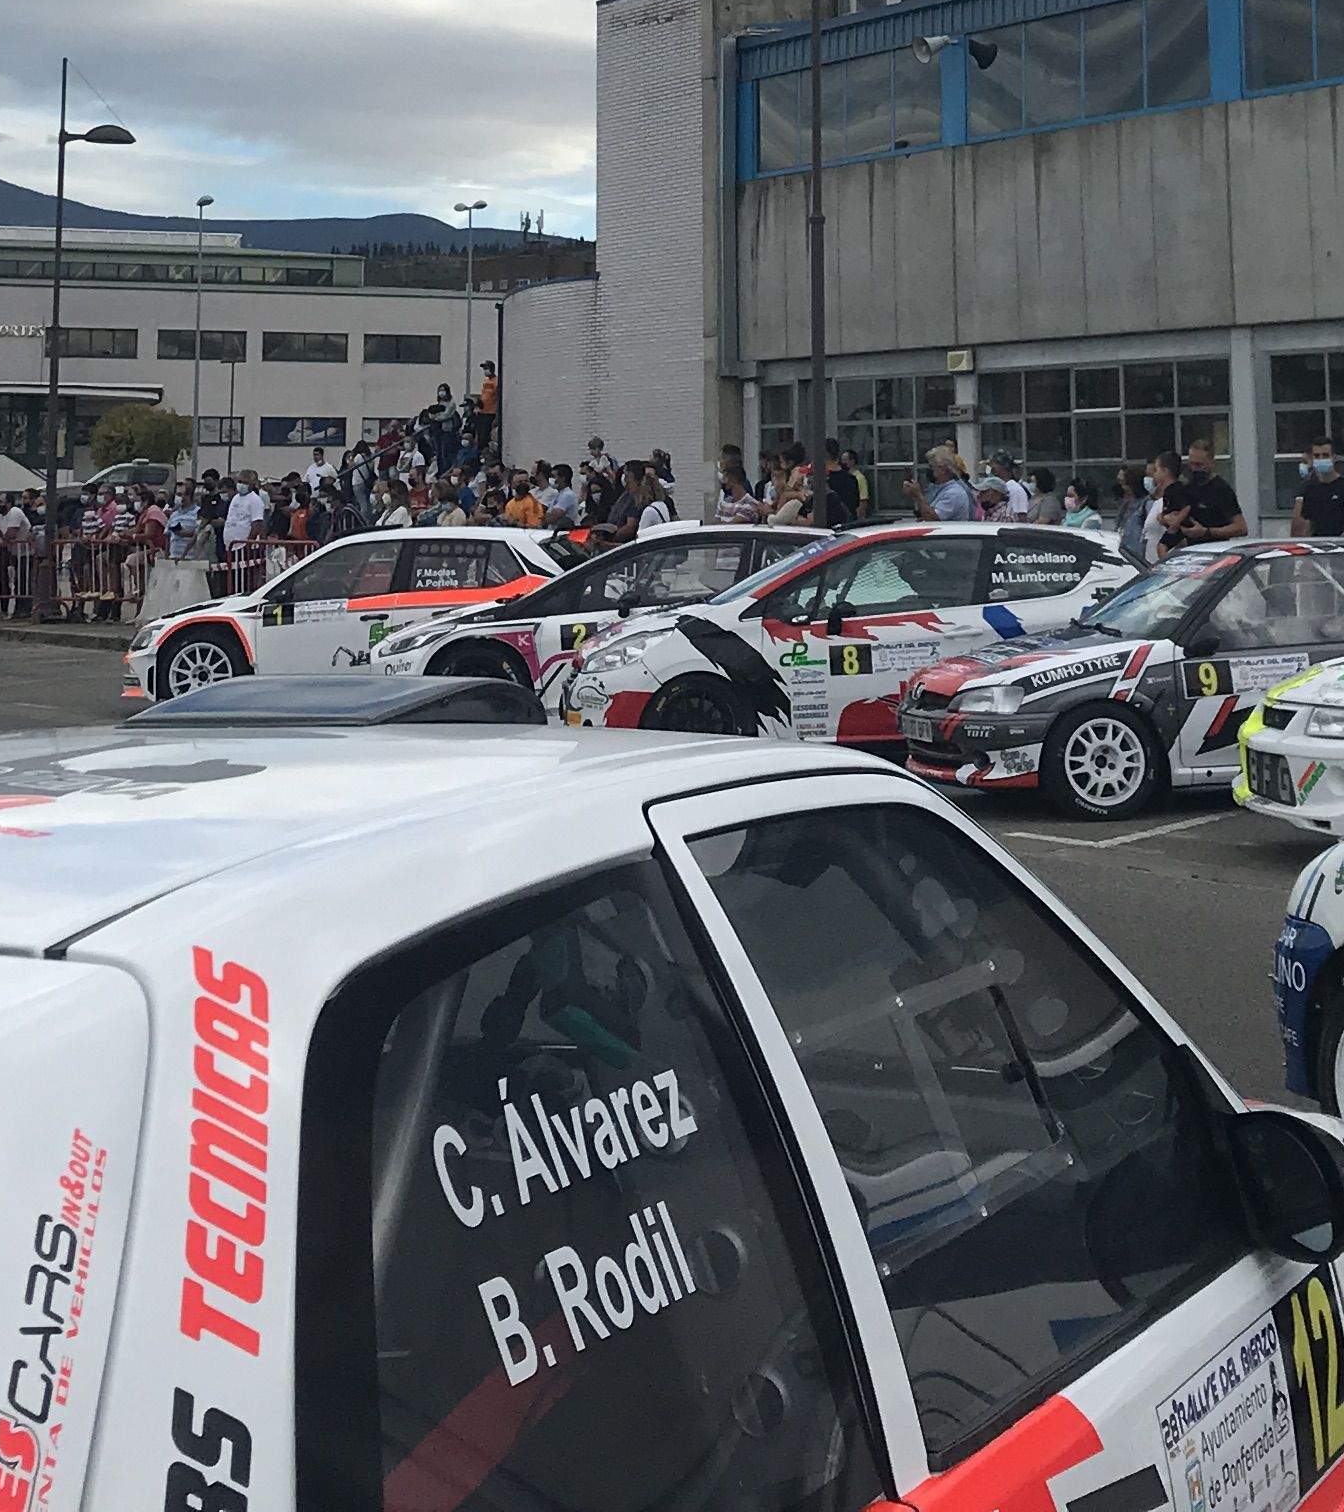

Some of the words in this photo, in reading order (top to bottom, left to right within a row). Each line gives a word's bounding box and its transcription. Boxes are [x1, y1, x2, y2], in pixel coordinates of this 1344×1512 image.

[991, 571, 1081, 584] M.Lumbreras
[994, 552, 1077, 566] A.Castellano
[272, 604, 282, 626] 1
[842, 645, 860, 675] 8
[1030, 657, 1085, 688] KUMHO
[1083, 653, 1122, 675] TYRE
[1198, 662, 1218, 696] 9
[181, 945, 270, 1358] TECNICAS
[498, 1068, 698, 1206] Álvarez
[544, 1200, 697, 1352] Rodil
[55, 1355, 74, 1408] DE
[1219, 1356, 1241, 1395] DEL
[1240, 1322, 1278, 1376] BIERZO
[1200, 1381, 1268, 1463] Ayuntamiento
[1208, 1477, 1222, 1510] de
[1221, 1422, 1275, 1491] Ponferrada
